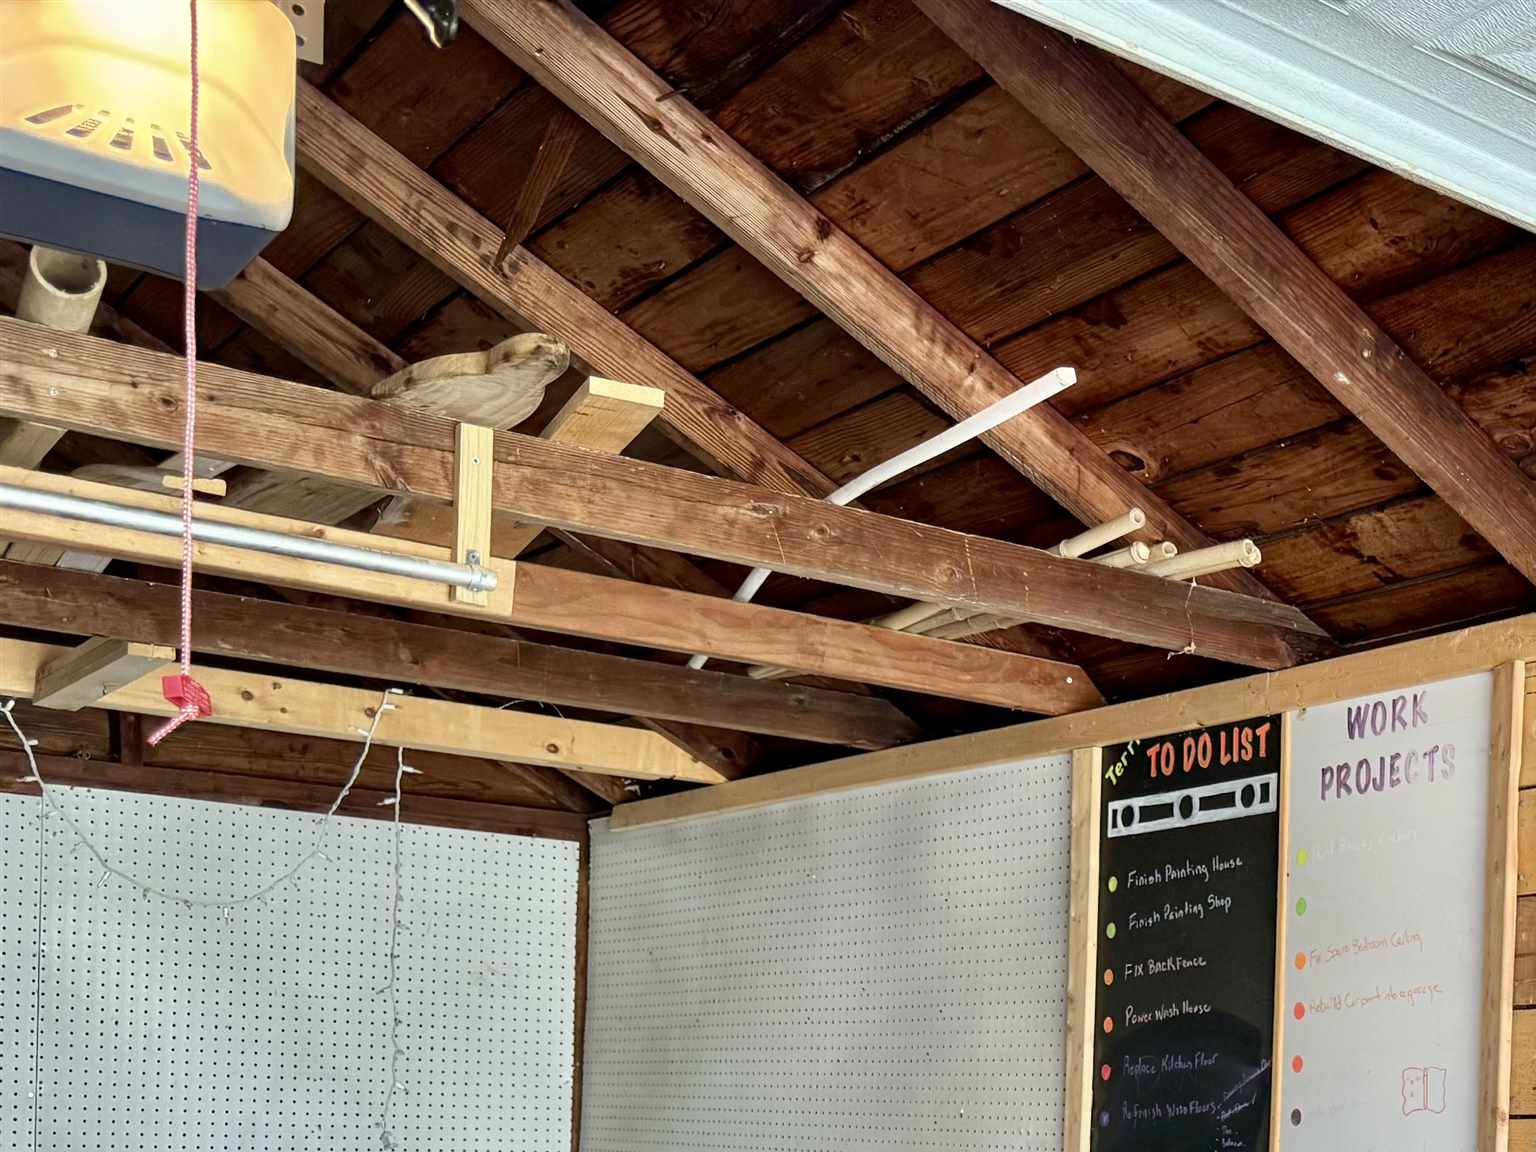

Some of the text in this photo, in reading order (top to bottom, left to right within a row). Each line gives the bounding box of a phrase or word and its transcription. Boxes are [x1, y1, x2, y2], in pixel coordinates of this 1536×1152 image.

[1347, 690, 1428, 740] WORK
[1105, 722, 1270, 786] Terr TO DO LIST
[1321, 744, 1456, 801] PROJECTS
[1127, 855, 1243, 888] Finish Painting House
[1128, 894, 1232, 930] Finish Painting Shop
[1155, 1003, 1180, 1021] Wash
